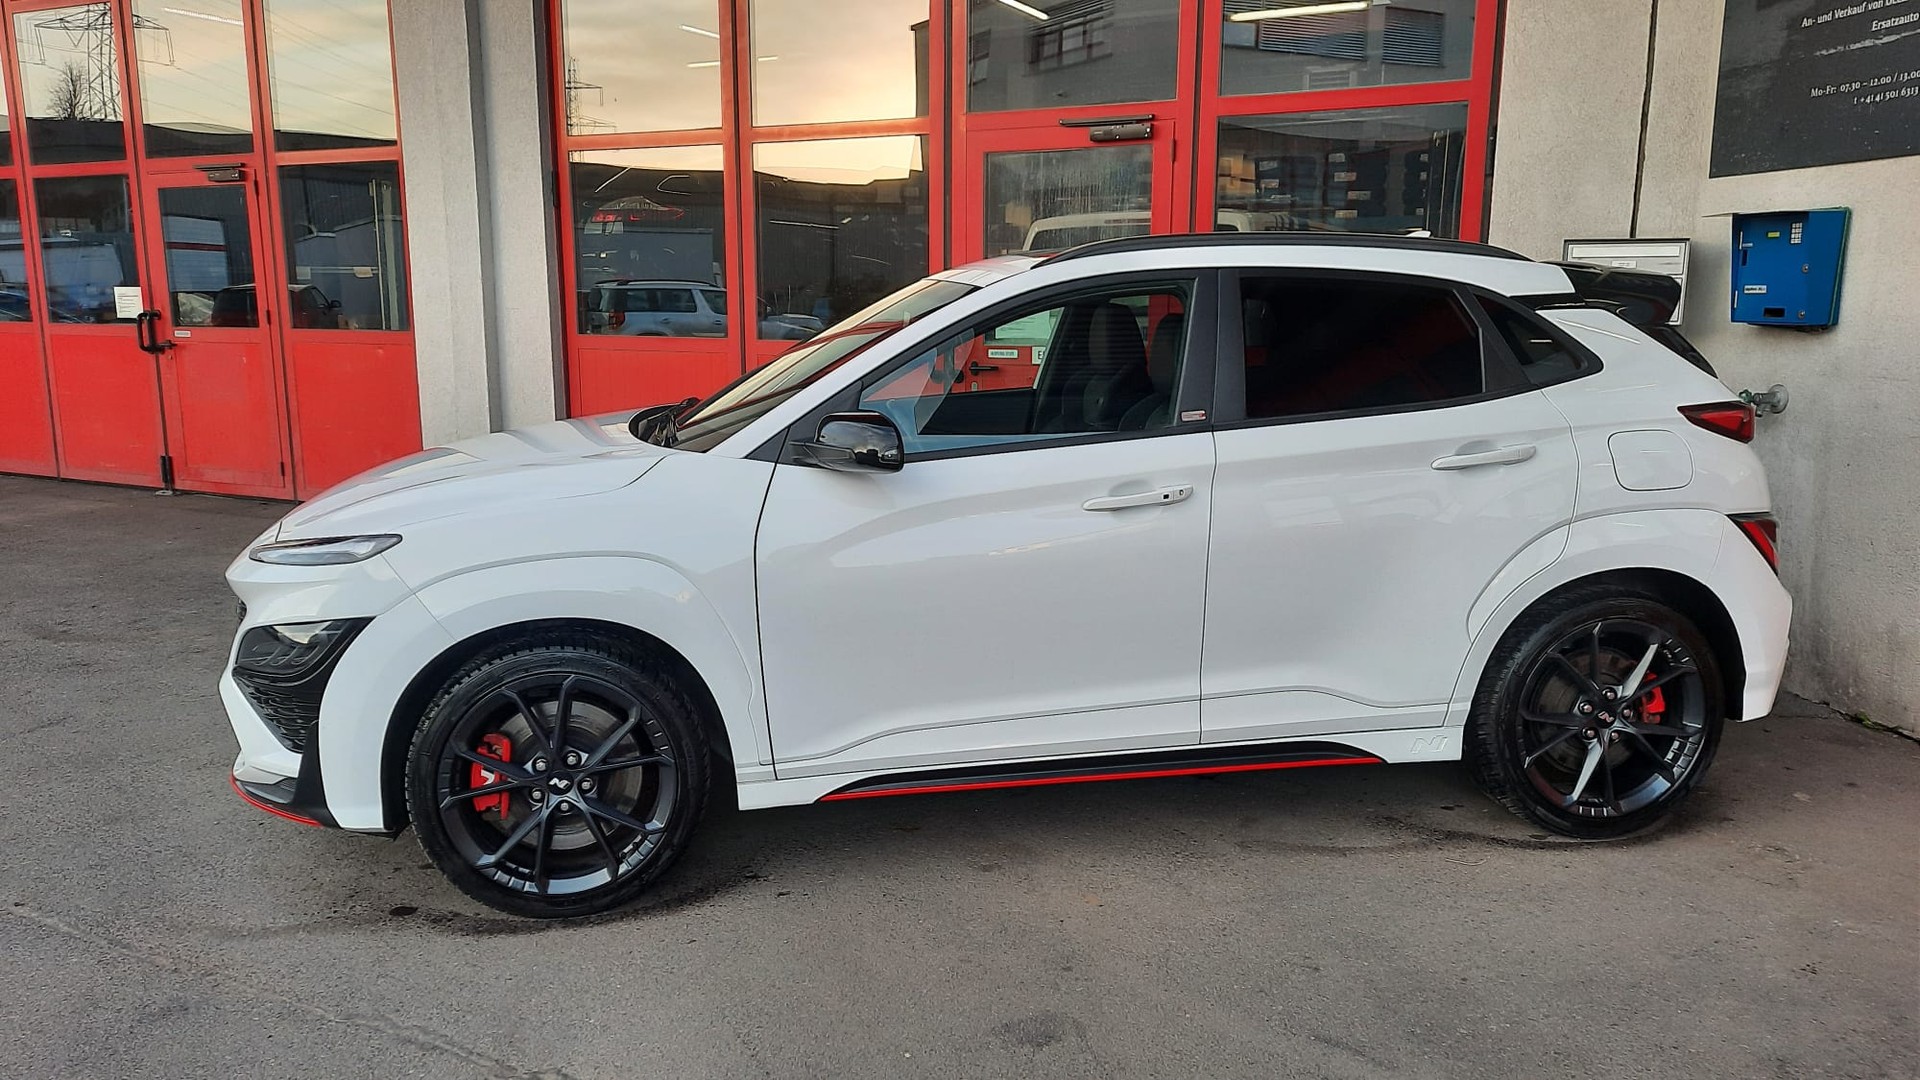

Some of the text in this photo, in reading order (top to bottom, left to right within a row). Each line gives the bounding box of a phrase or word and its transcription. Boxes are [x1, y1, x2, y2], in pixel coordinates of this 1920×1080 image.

[1801, 17, 1816, 28] An-
[1817, 11, 1833, 24] und
[1834, 2, 1867, 18] Verkauf
[1868, 0, 1884, 10] von
[1810, 85, 1837, 97] Mo-Fr:
[1840, 81, 1861, 93] 07.30
[1870, 75, 1892, 87] 12.00
[1900, 86, 1919, 98] 6313
